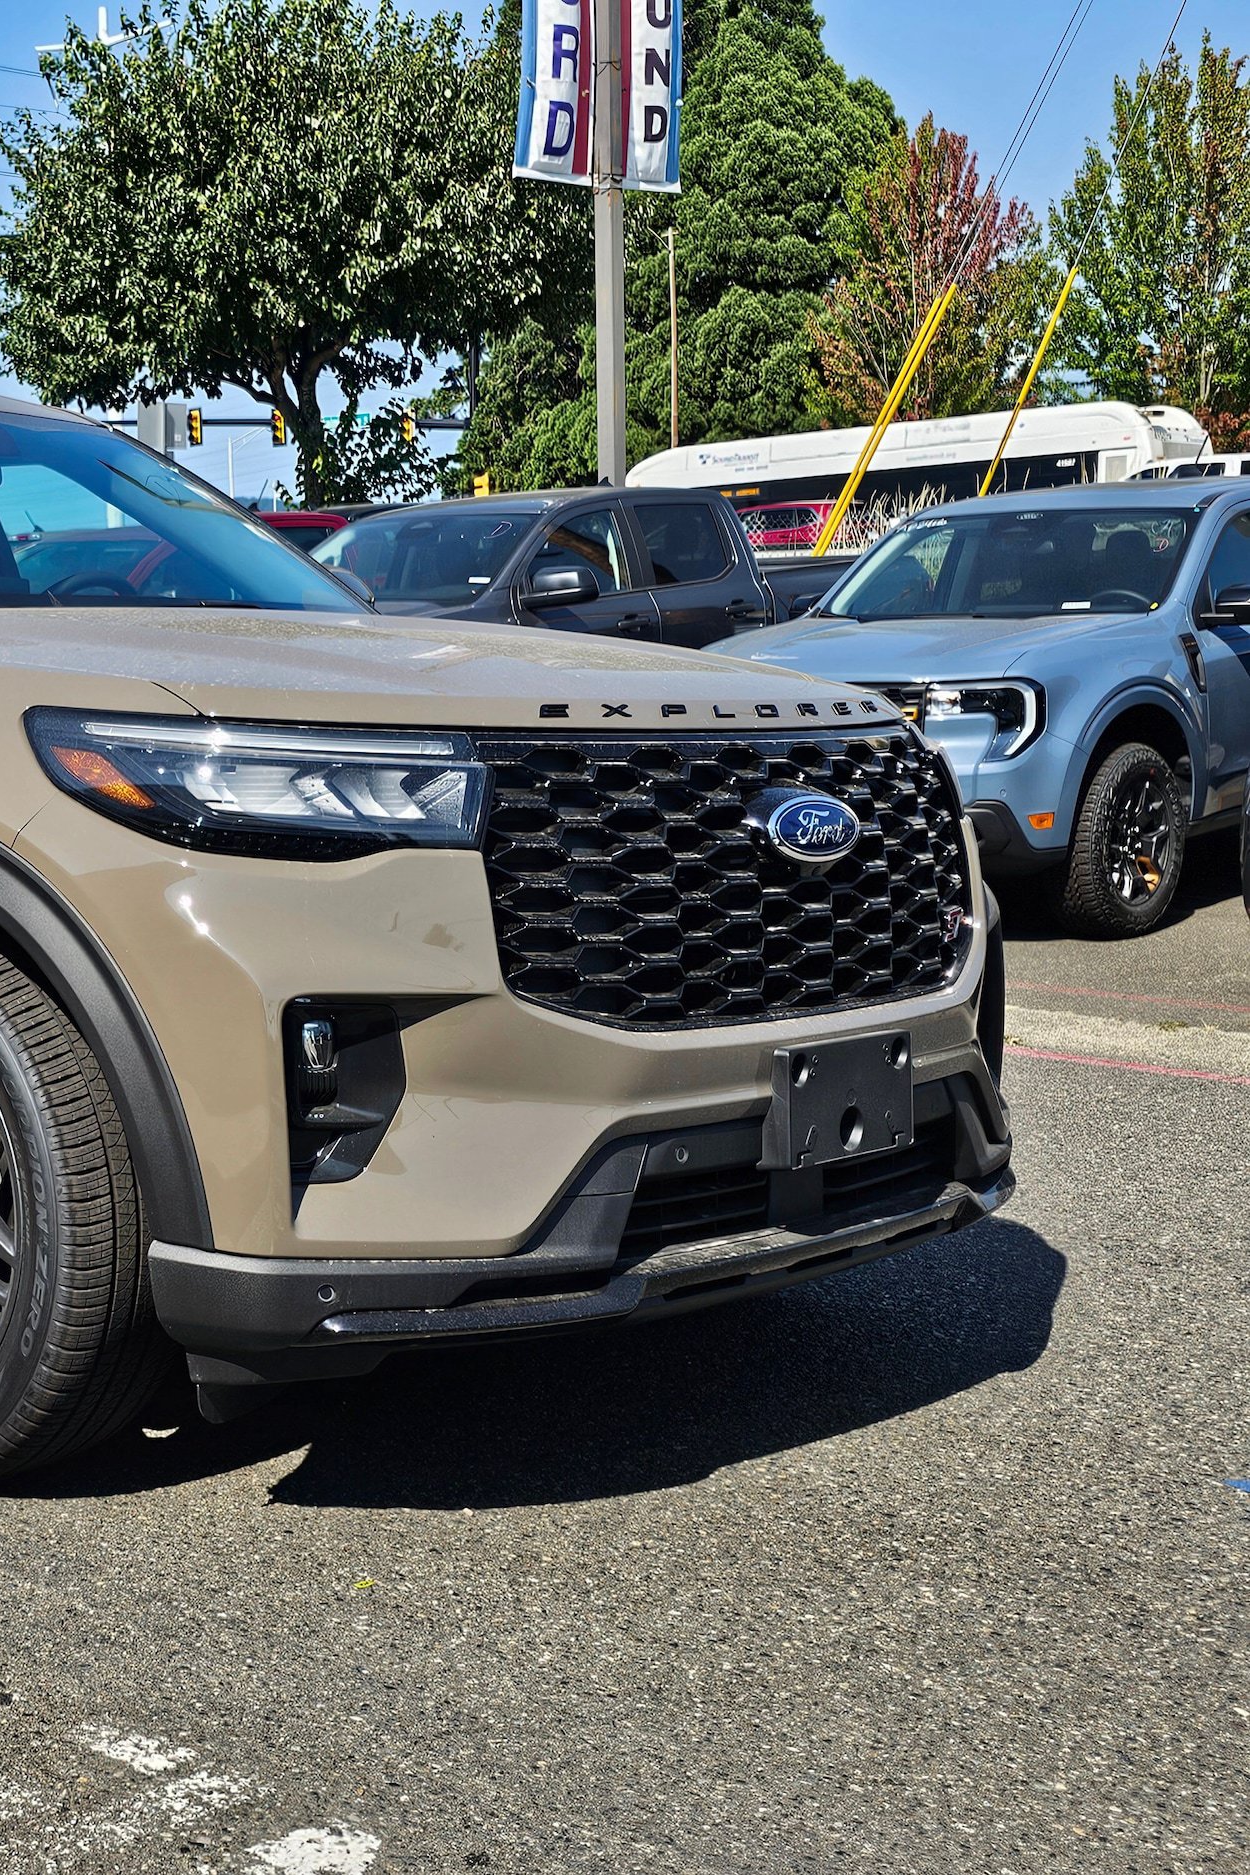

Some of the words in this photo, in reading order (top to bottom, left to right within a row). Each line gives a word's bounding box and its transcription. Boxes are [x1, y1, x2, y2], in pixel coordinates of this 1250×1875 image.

[543, 0, 580, 157] RD
[539, 703, 879, 719] EXPLORER
[797, 809, 846, 845] Ford
[20, 1245, 49, 1358] ZERO
